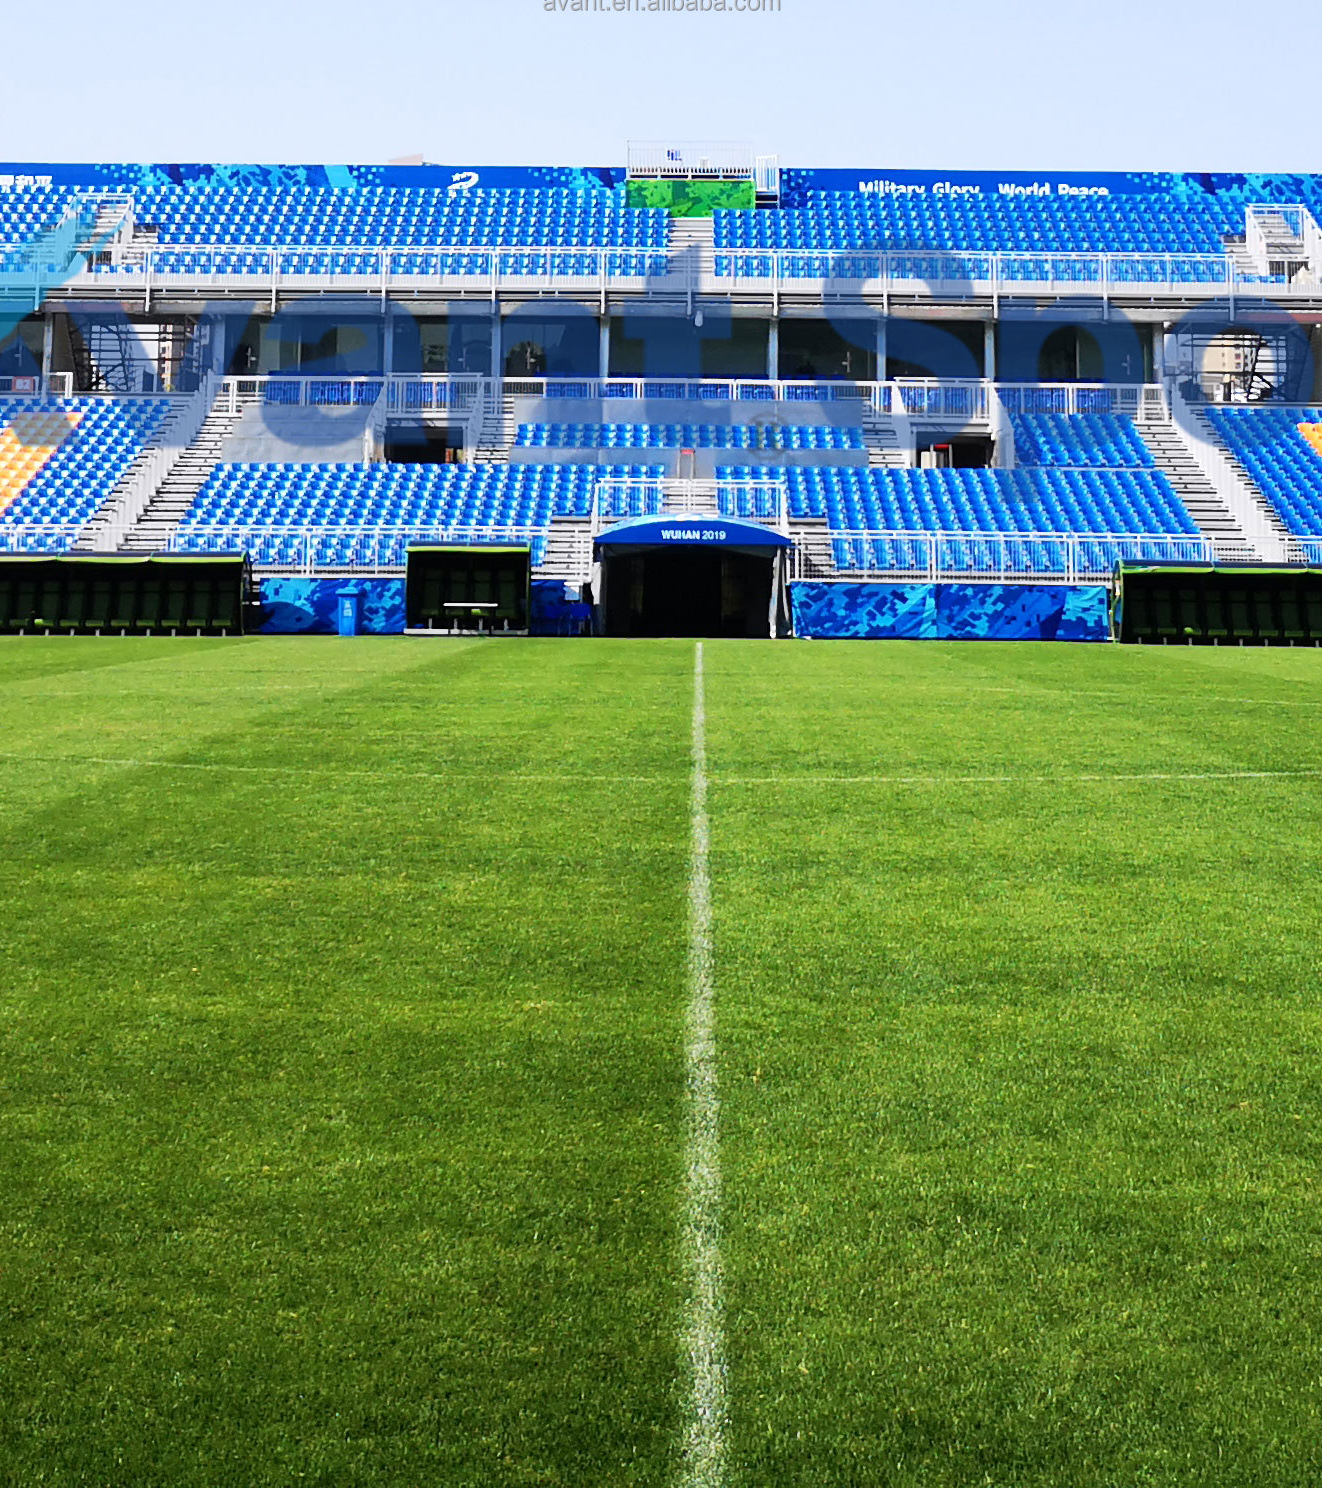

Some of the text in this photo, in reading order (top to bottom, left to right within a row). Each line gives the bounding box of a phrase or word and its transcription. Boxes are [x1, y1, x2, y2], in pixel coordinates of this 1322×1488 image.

[858, 179, 1110, 197] Military Glory World Peace
[661, 529, 727, 540] WUHAN 2019
